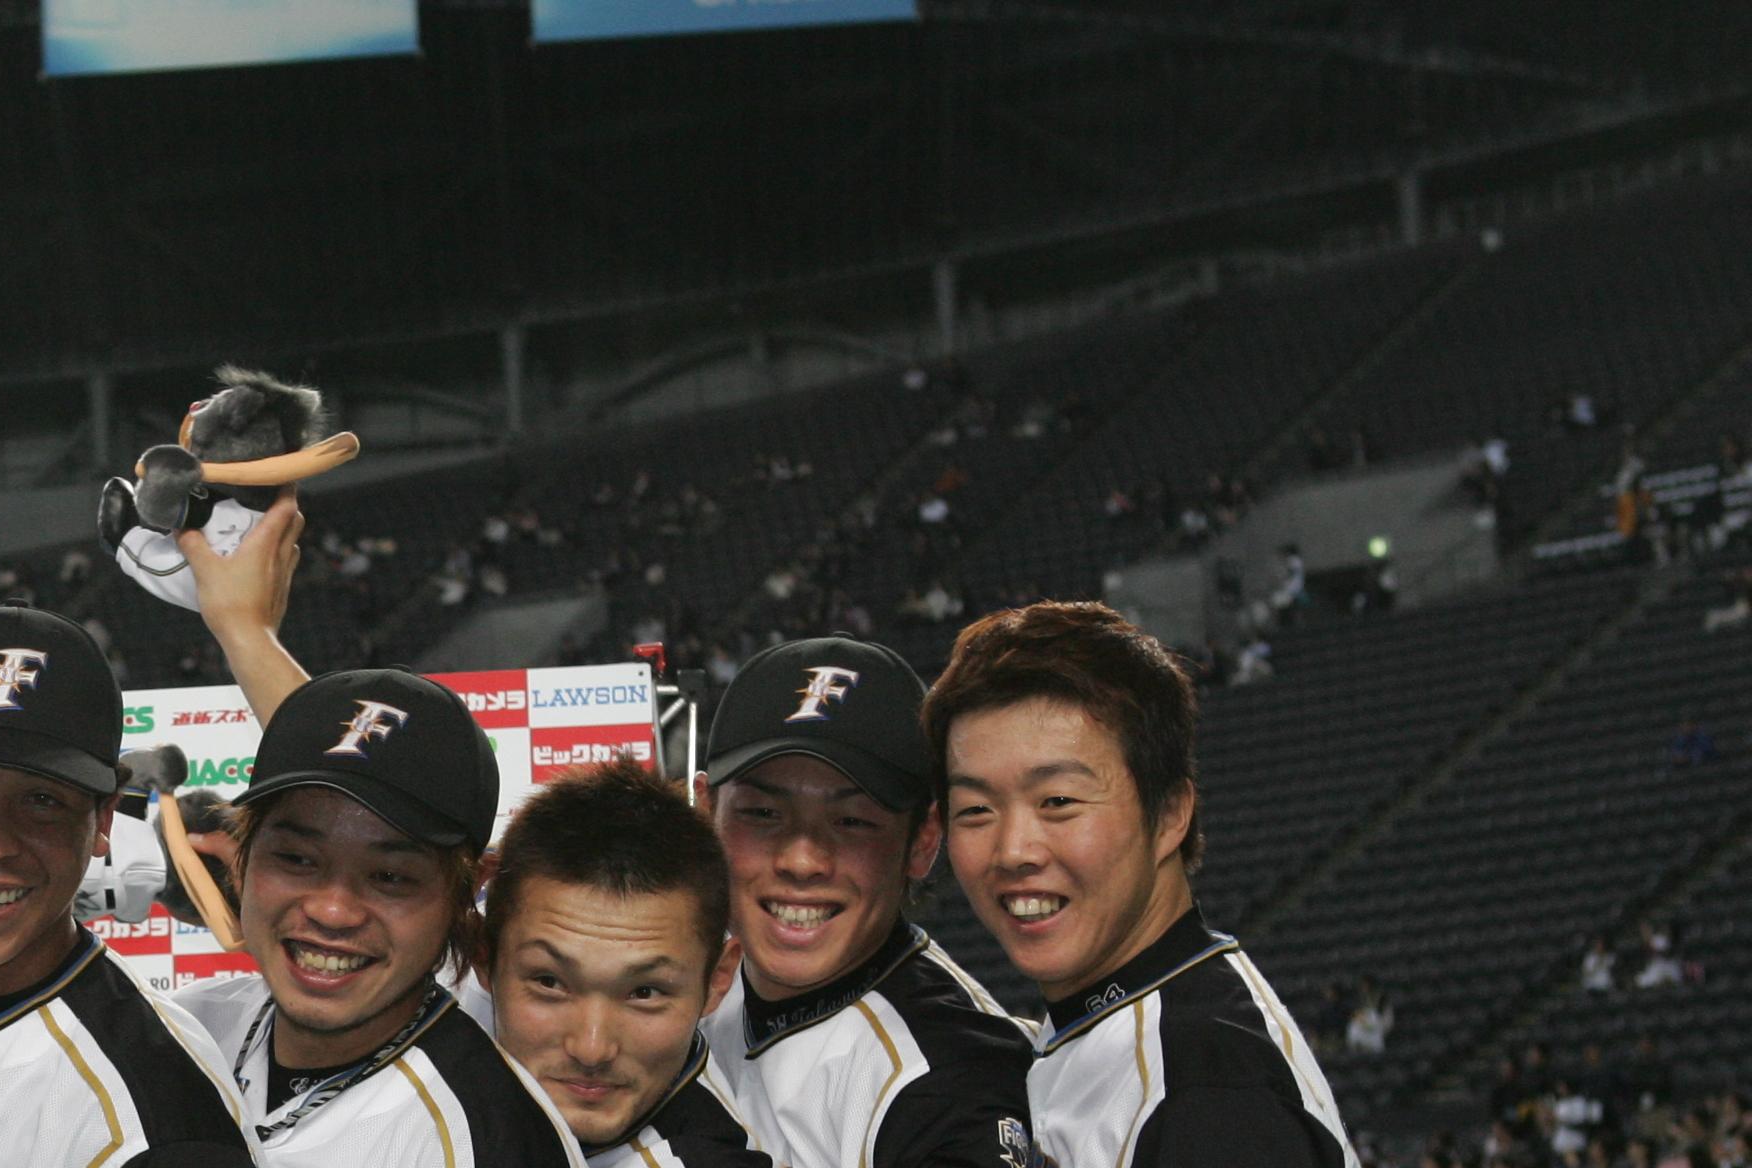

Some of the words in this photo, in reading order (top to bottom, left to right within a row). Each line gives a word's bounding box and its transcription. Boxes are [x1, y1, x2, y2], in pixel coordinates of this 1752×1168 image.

[532, 685, 647, 708] LAWSON
[784, 666, 860, 724] F
[323, 699, 409, 759] F
